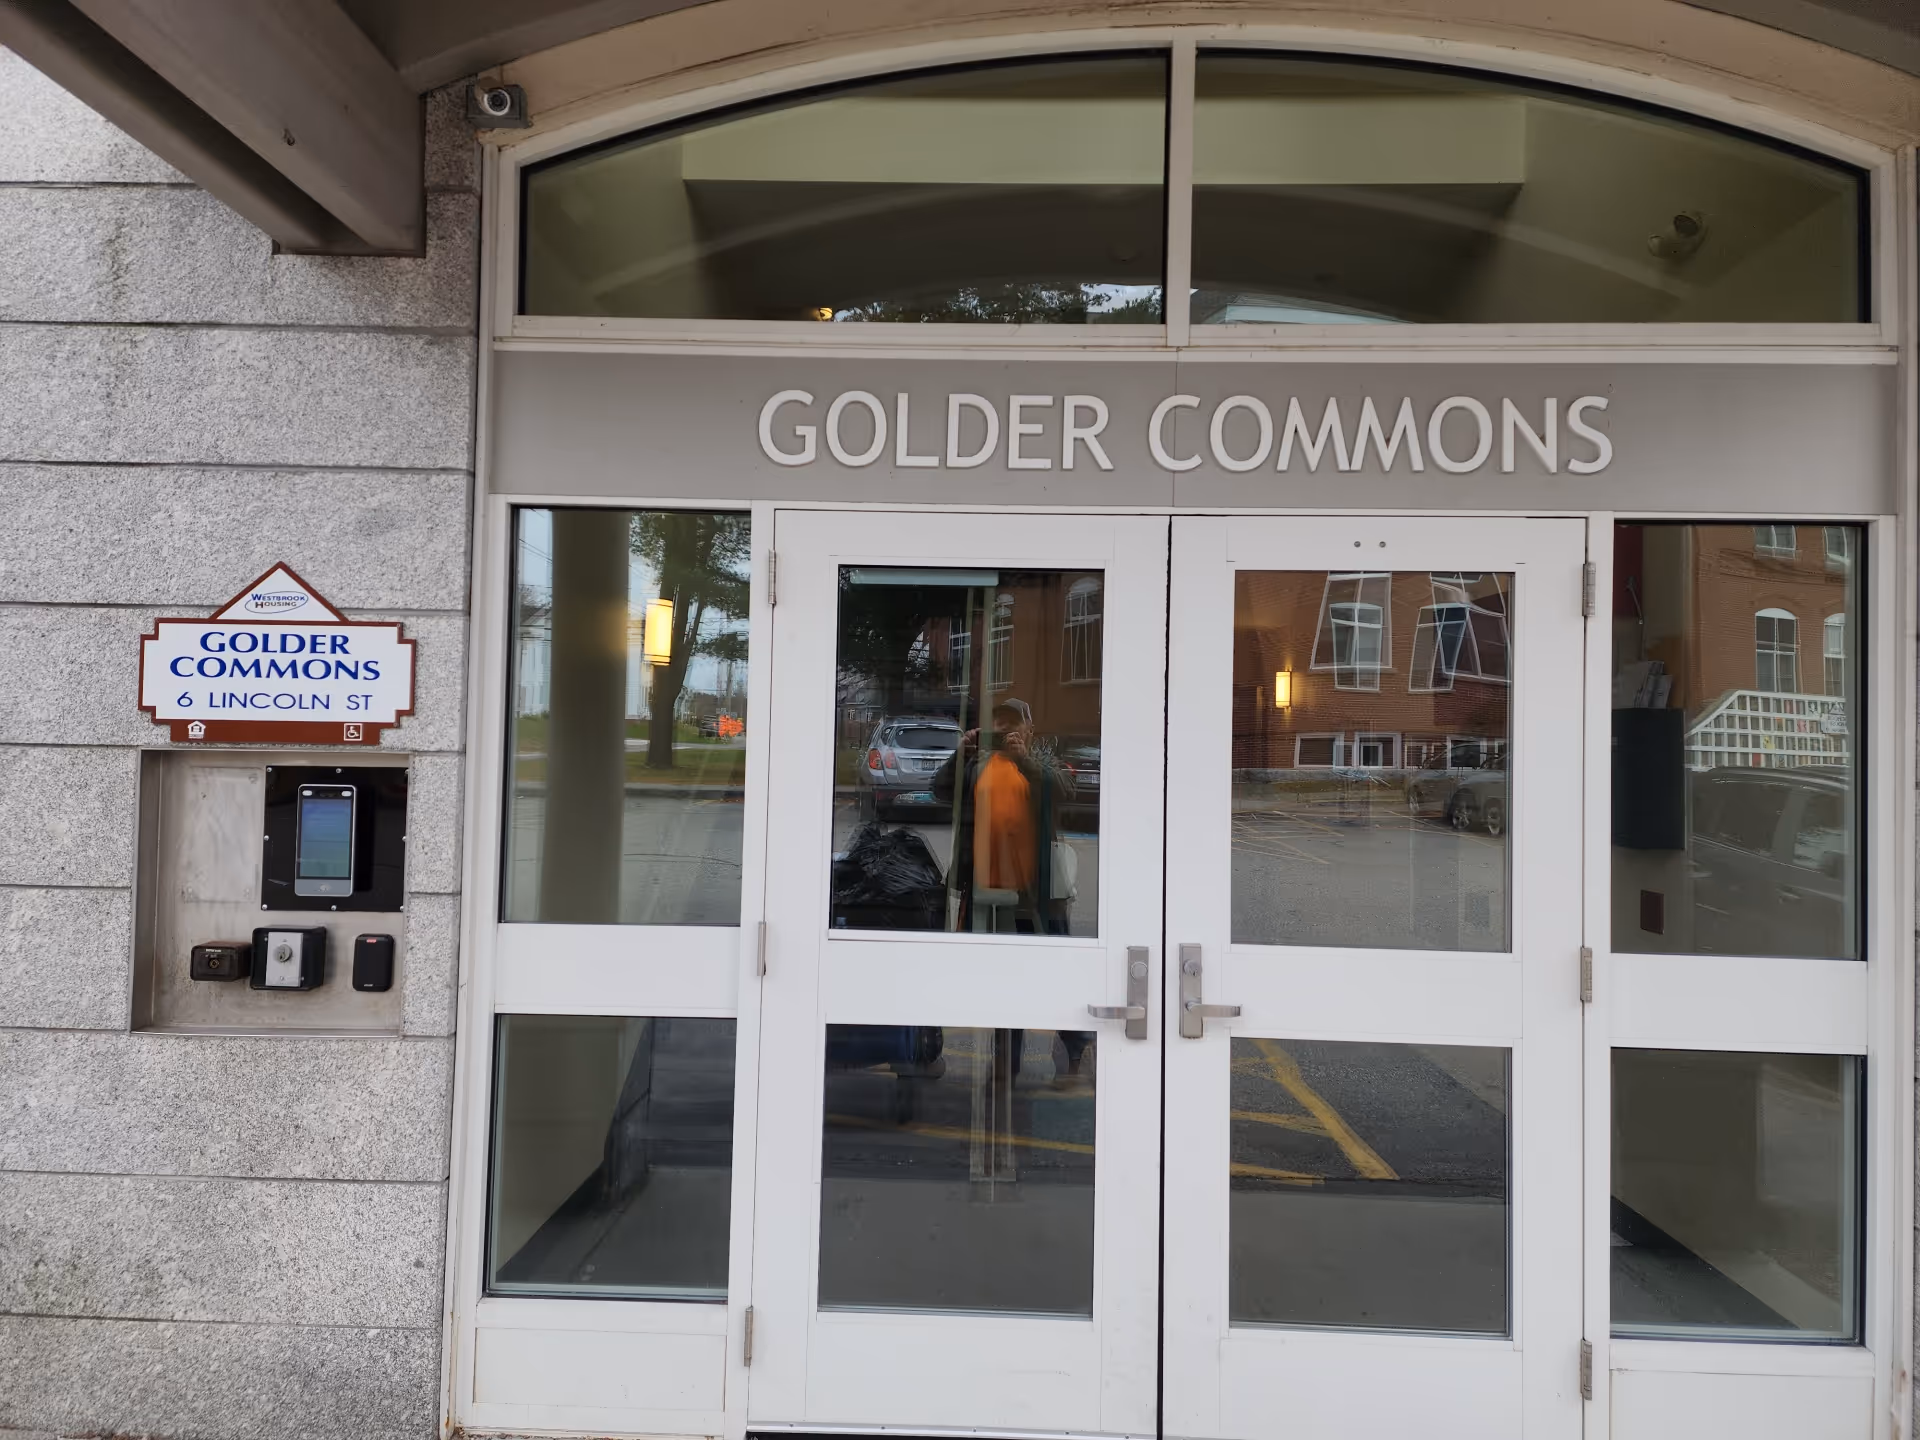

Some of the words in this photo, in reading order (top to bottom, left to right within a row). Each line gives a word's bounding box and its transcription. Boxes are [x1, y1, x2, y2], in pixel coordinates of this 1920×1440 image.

[758, 389, 1115, 470] GOLDER
[1148, 394, 1613, 474] COMMONS
[251, 593, 306, 602] WESTBROOK
[255, 601, 297, 609] HOUSING
[199, 631, 351, 655] GOLDER
[169, 656, 381, 681] COMMONS
[176, 691, 194, 708] 6
[208, 691, 330, 711] LINCOLN
[346, 694, 373, 711] ST
